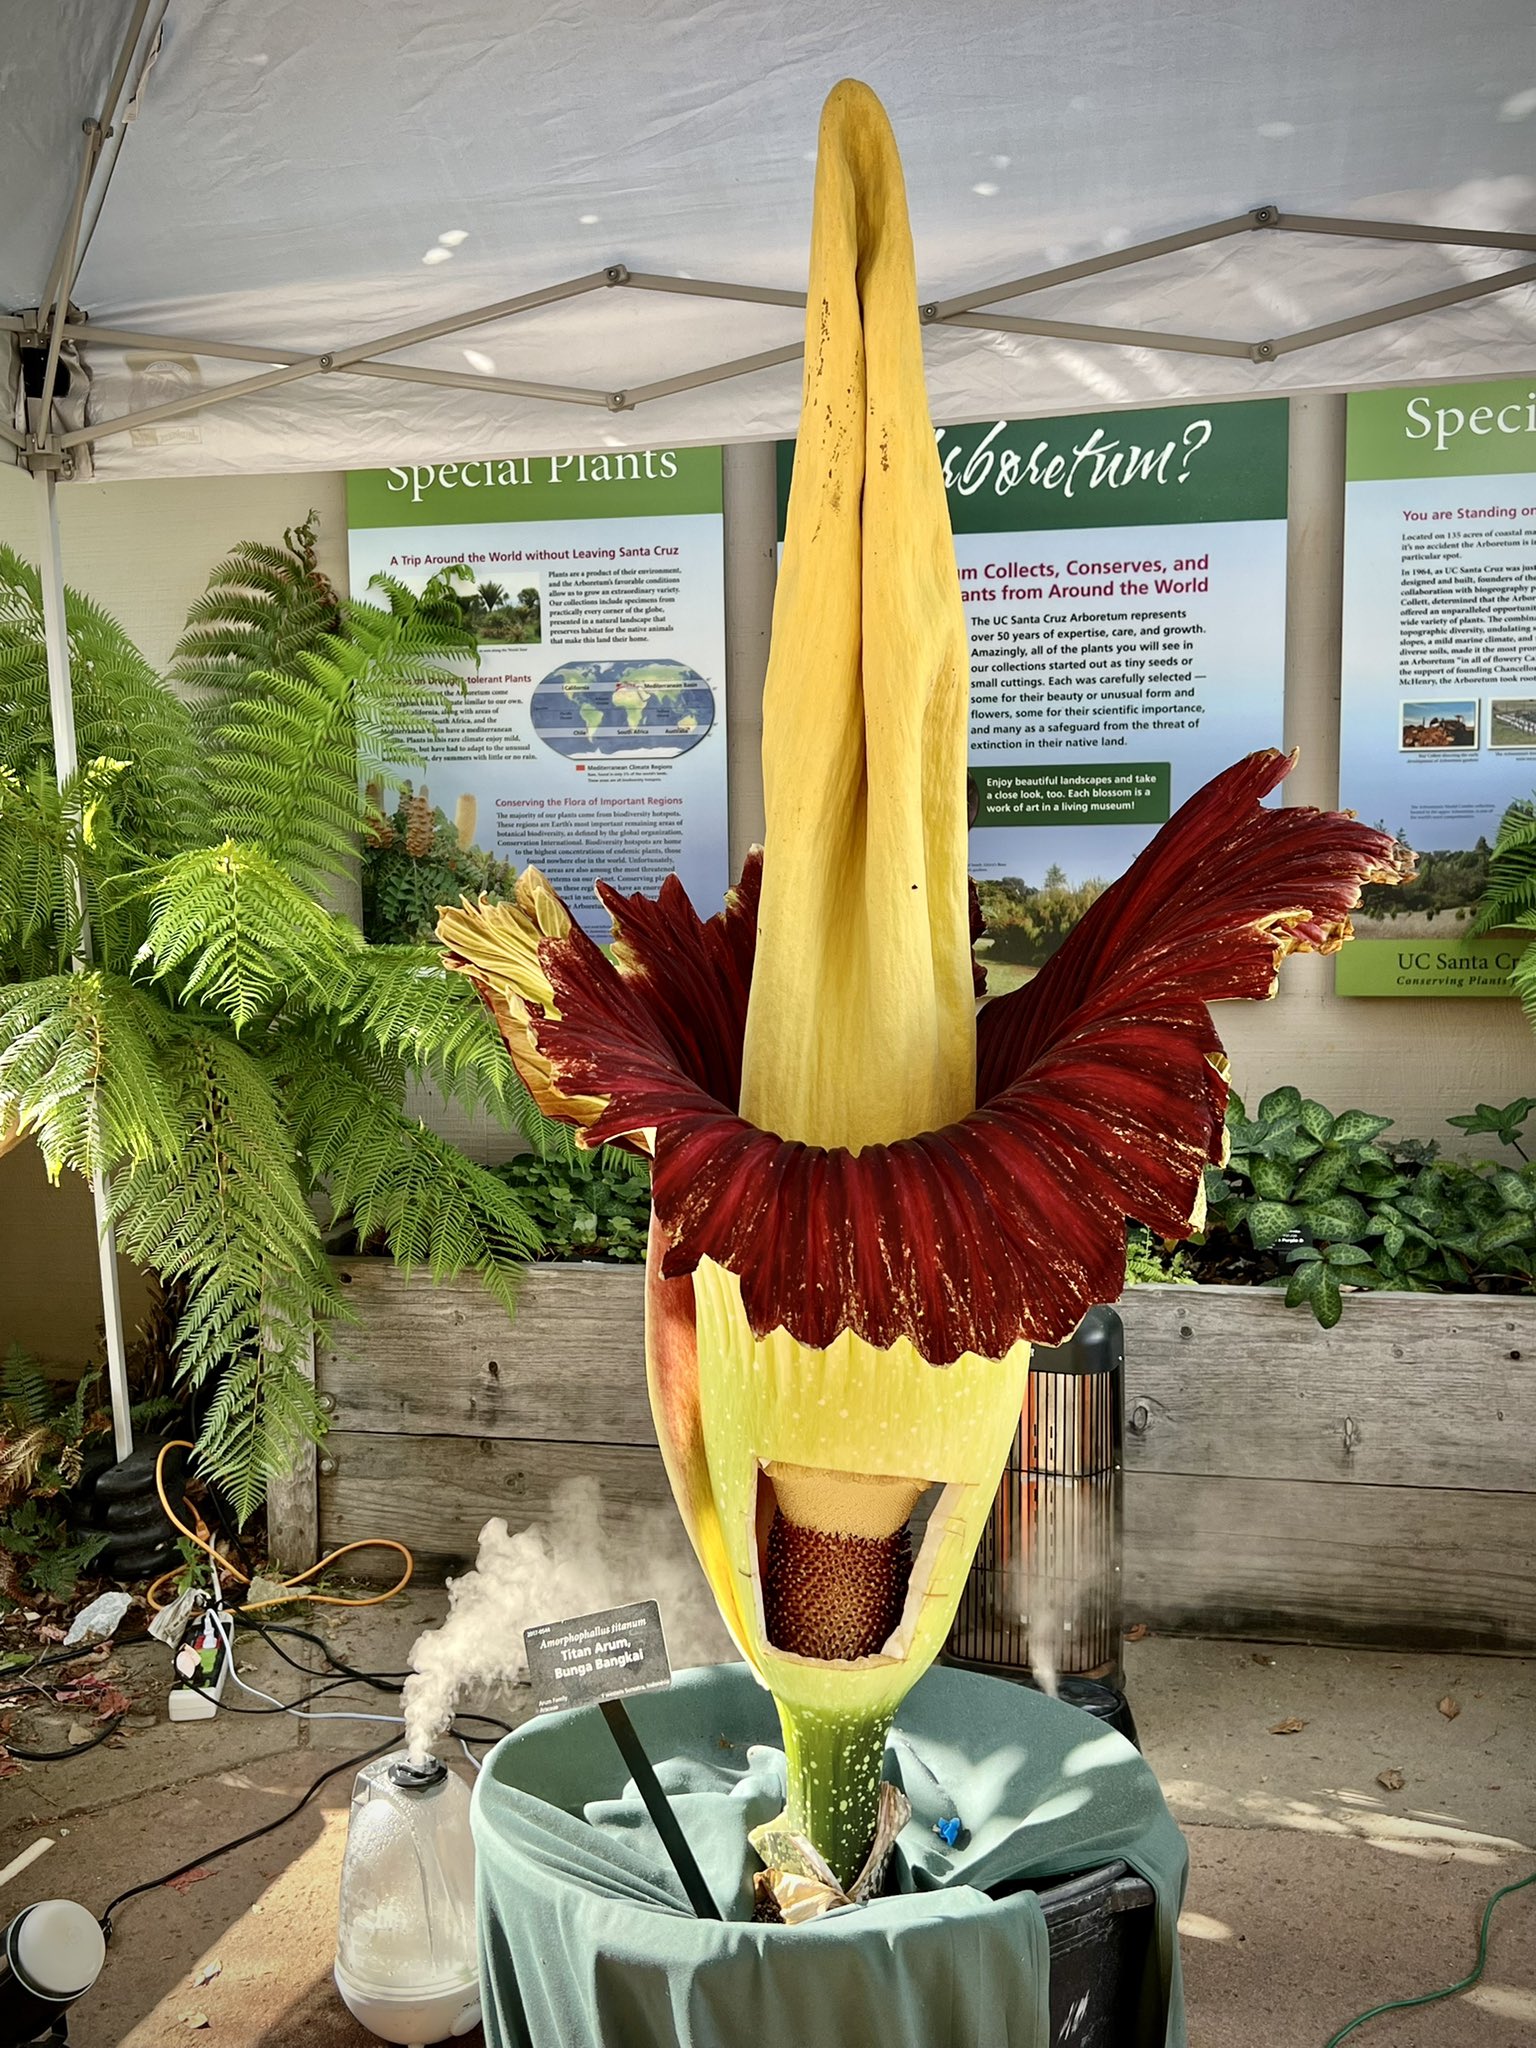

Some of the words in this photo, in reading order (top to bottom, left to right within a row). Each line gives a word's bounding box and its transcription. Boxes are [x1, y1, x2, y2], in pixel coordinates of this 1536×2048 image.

[933, 419, 1212, 498] rboretum?
[386, 458, 533, 502] Special
[547, 450, 679, 484] Plants
[1403, 510, 1427, 521] You
[1432, 512, 1452, 520] are
[1457, 506, 1516, 520] Standing
[1402, 533, 1432, 541] Located
[1494, 530, 1522, 538] coastal
[390, 555, 398, 566] A
[401, 554, 420, 568] Trip
[424, 552, 464, 565] Around
[468, 552, 485, 563] the
[488, 550, 521, 563] World
[525, 549, 569, 561] without
[573, 547, 615, 563] Leaving
[619, 546, 650, 558] Santa
[654, 545, 678, 557] Cruz
[548, 570, 568, 578] Plants
[586, 569, 611, 580] product
[638, 568, 681, 577] environment,
[984, 562, 1060, 579] Collects,
[1066, 559, 1167, 576] Conserves,
[1173, 554, 1209, 571] and
[961, 588, 996, 602] ants
[1001, 585, 1042, 600] from
[1048, 581, 1113, 598] Around
[1119, 582, 1148, 595] the
[1154, 578, 1208, 594] World
[971, 614, 989, 626] The
[993, 614, 1007, 625] UC
[1011, 613, 1039, 625] Santa
[1043, 612, 1066, 624] Cruz
[1070, 611, 1127, 623] Arboretum
[1131, 609, 1186, 624] represents
[971, 634, 994, 643] over
[998, 630, 1009, 642] 50
[1012, 632, 1040, 645] years
[1043, 628, 1054, 641] of
[1057, 627, 1108, 644] expertise,
[1112, 629, 1136, 640] care,
[1140, 625, 1159, 638] and
[1163, 624, 1205, 641] growth.
[971, 645, 1027, 661] Amazingly,
[1031, 645, 1042, 656] all
[1046, 644, 1057, 656] of
[1060, 644, 1077, 655] the
[1081, 643, 1112, 658] plants
[1116, 645, 1136, 656] you
[1140, 641, 1158, 653] will
[1162, 644, 1179, 652] see
[1183, 640, 1192, 651] in
[991, 661, 1045, 672] collections
[1049, 659, 1085, 670] started
[1089, 659, 1106, 669] out
[1125, 658, 1145, 671] tiny
[1148, 656, 1178, 667] seeds
[505, 674, 531, 683] Plants
[971, 678, 997, 689] small
[1000, 676, 1044, 691] cuttings.
[1048, 676, 1072, 687] Each
[1075, 678, 1096, 686] was
[1099, 674, 1144, 688] carefully
[1148, 672, 1191, 684] selected
[971, 696, 997, 704] some
[1001, 693, 1016, 703] for
[1019, 692, 1043, 702] their
[1047, 690, 1082, 704] beauty
[1101, 689, 1142, 700] unusual
[1146, 688, 1170, 699] form
[1174, 687, 1194, 698] and
[971, 708, 1012, 721] flowers,
[1016, 710, 1042, 719] some
[1046, 707, 1061, 718] for
[1065, 706, 1089, 718] their
[1092, 705, 1138, 717] scientific
[1142, 703, 1204, 719] importance,
[970, 724, 989, 735] and
[993, 726, 1021, 737] many
[1048, 721, 1099, 735] safeguard
[1103, 720, 1128, 731] from
[1132, 720, 1148, 730] the
[1152, 718, 1184, 730] threat
[1188, 718, 1198, 728] of
[970, 738, 1021, 750] extinction
[1025, 738, 1034, 749] in
[1038, 737, 1062, 748] their
[1066, 736, 1098, 748] native
[1102, 735, 1126, 746] land.
[987, 776, 1012, 791] Enjoy
[1015, 775, 1057, 787] beautiful
[1060, 774, 1111, 789] landscapes
[1114, 774, 1132, 785] and
[1135, 773, 1156, 784] take
[994, 789, 1017, 800] close
[1020, 789, 1043, 801] look,
[1046, 789, 1064, 799] too.
[1068, 788, 1089, 798] Each
[1092, 787, 1131, 798] blossom
[1134, 787, 1142, 797] is
[495, 798, 544, 810] Conserving
[547, 798, 561, 807] the
[564, 798, 585, 807] Flora
[588, 798, 597, 807] of
[600, 797, 644, 809] Important
[648, 797, 682, 809] Regions
[986, 802, 1010, 813] work
[1013, 802, 1023, 812] of
[1026, 802, 1039, 812] art
[1042, 802, 1050, 812] in
[1062, 801, 1087, 814] living
[1090, 800, 1134, 811] museum!
[1398, 952, 1430, 970] UC
[1436, 952, 1488, 970] Santa
[1495, 952, 1520, 970] Cr
[1396, 976, 1464, 987] Conserving
[1469, 976, 1506, 985] Plants
[539, 1626, 610, 1650] Amorphophallus
[611, 1618, 646, 1633] titanum
[561, 1646, 592, 1661] Titan
[594, 1638, 631, 1654] Arum,
[554, 1663, 593, 1679] Bunga
[595, 1648, 644, 1670] Bangkai
